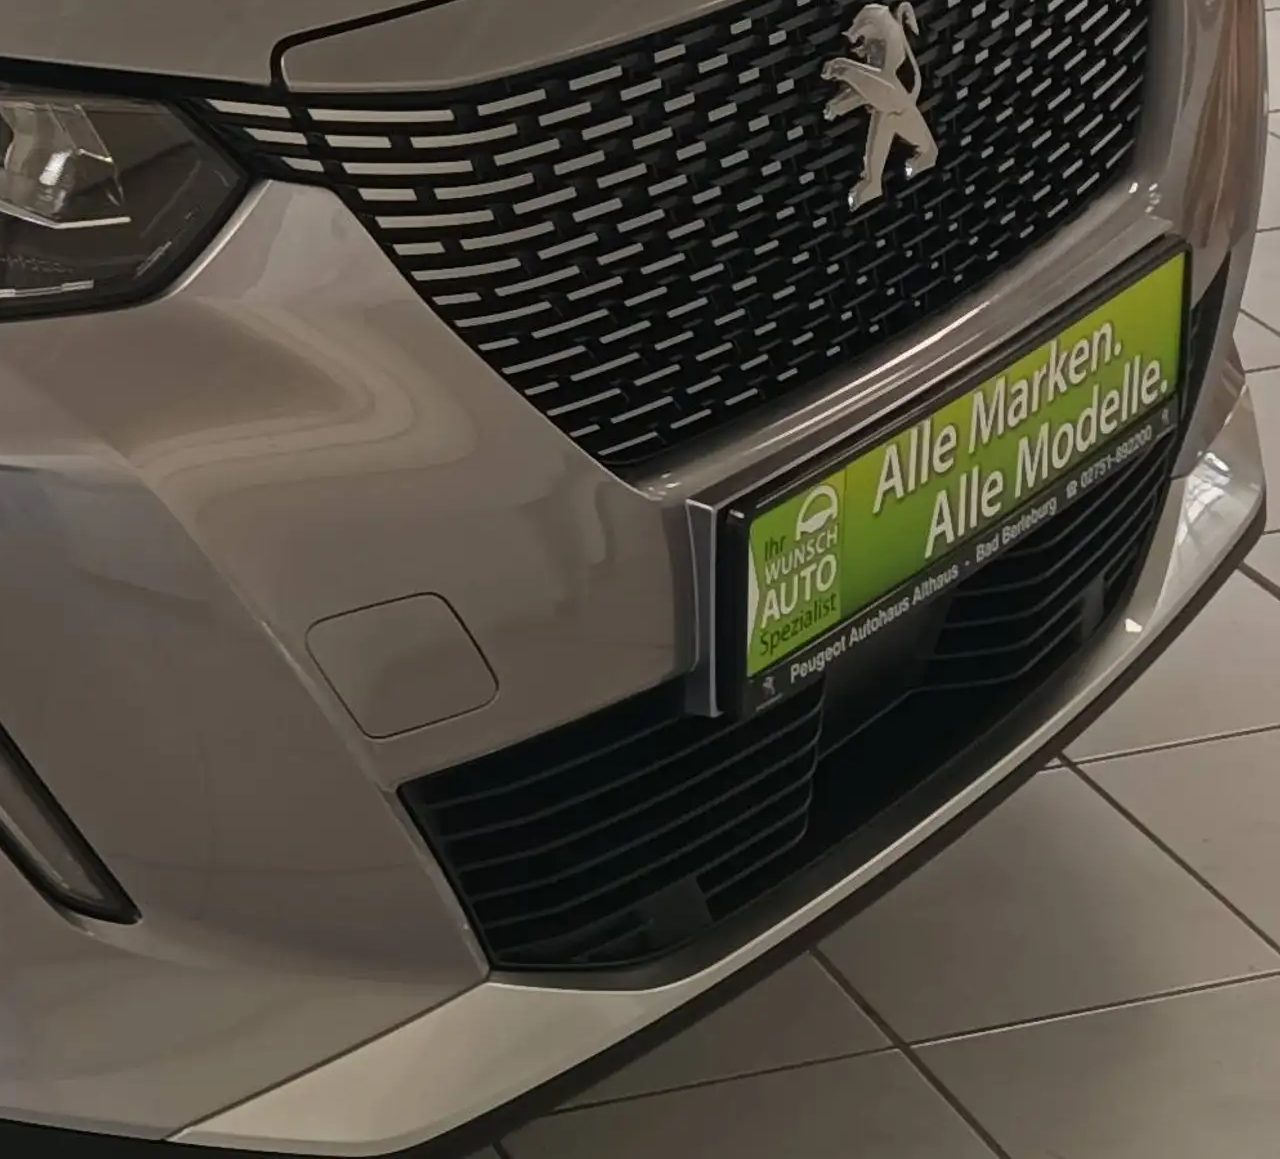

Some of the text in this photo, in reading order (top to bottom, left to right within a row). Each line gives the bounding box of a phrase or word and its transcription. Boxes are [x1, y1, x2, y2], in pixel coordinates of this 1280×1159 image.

[871, 322, 1123, 514] Alle Marken.
[924, 354, 1168, 559] Alle Modelle.
[764, 534, 786, 561] Ihr
[764, 525, 838, 586] WUNSCH
[759, 592, 837, 657] Spezialist
[760, 553, 837, 629] AUTO
[790, 635, 848, 684] Peugeot
[848, 595, 910, 648] Autohaus
[911, 564, 959, 606] Althaus
[976, 532, 1000, 563] Bad
